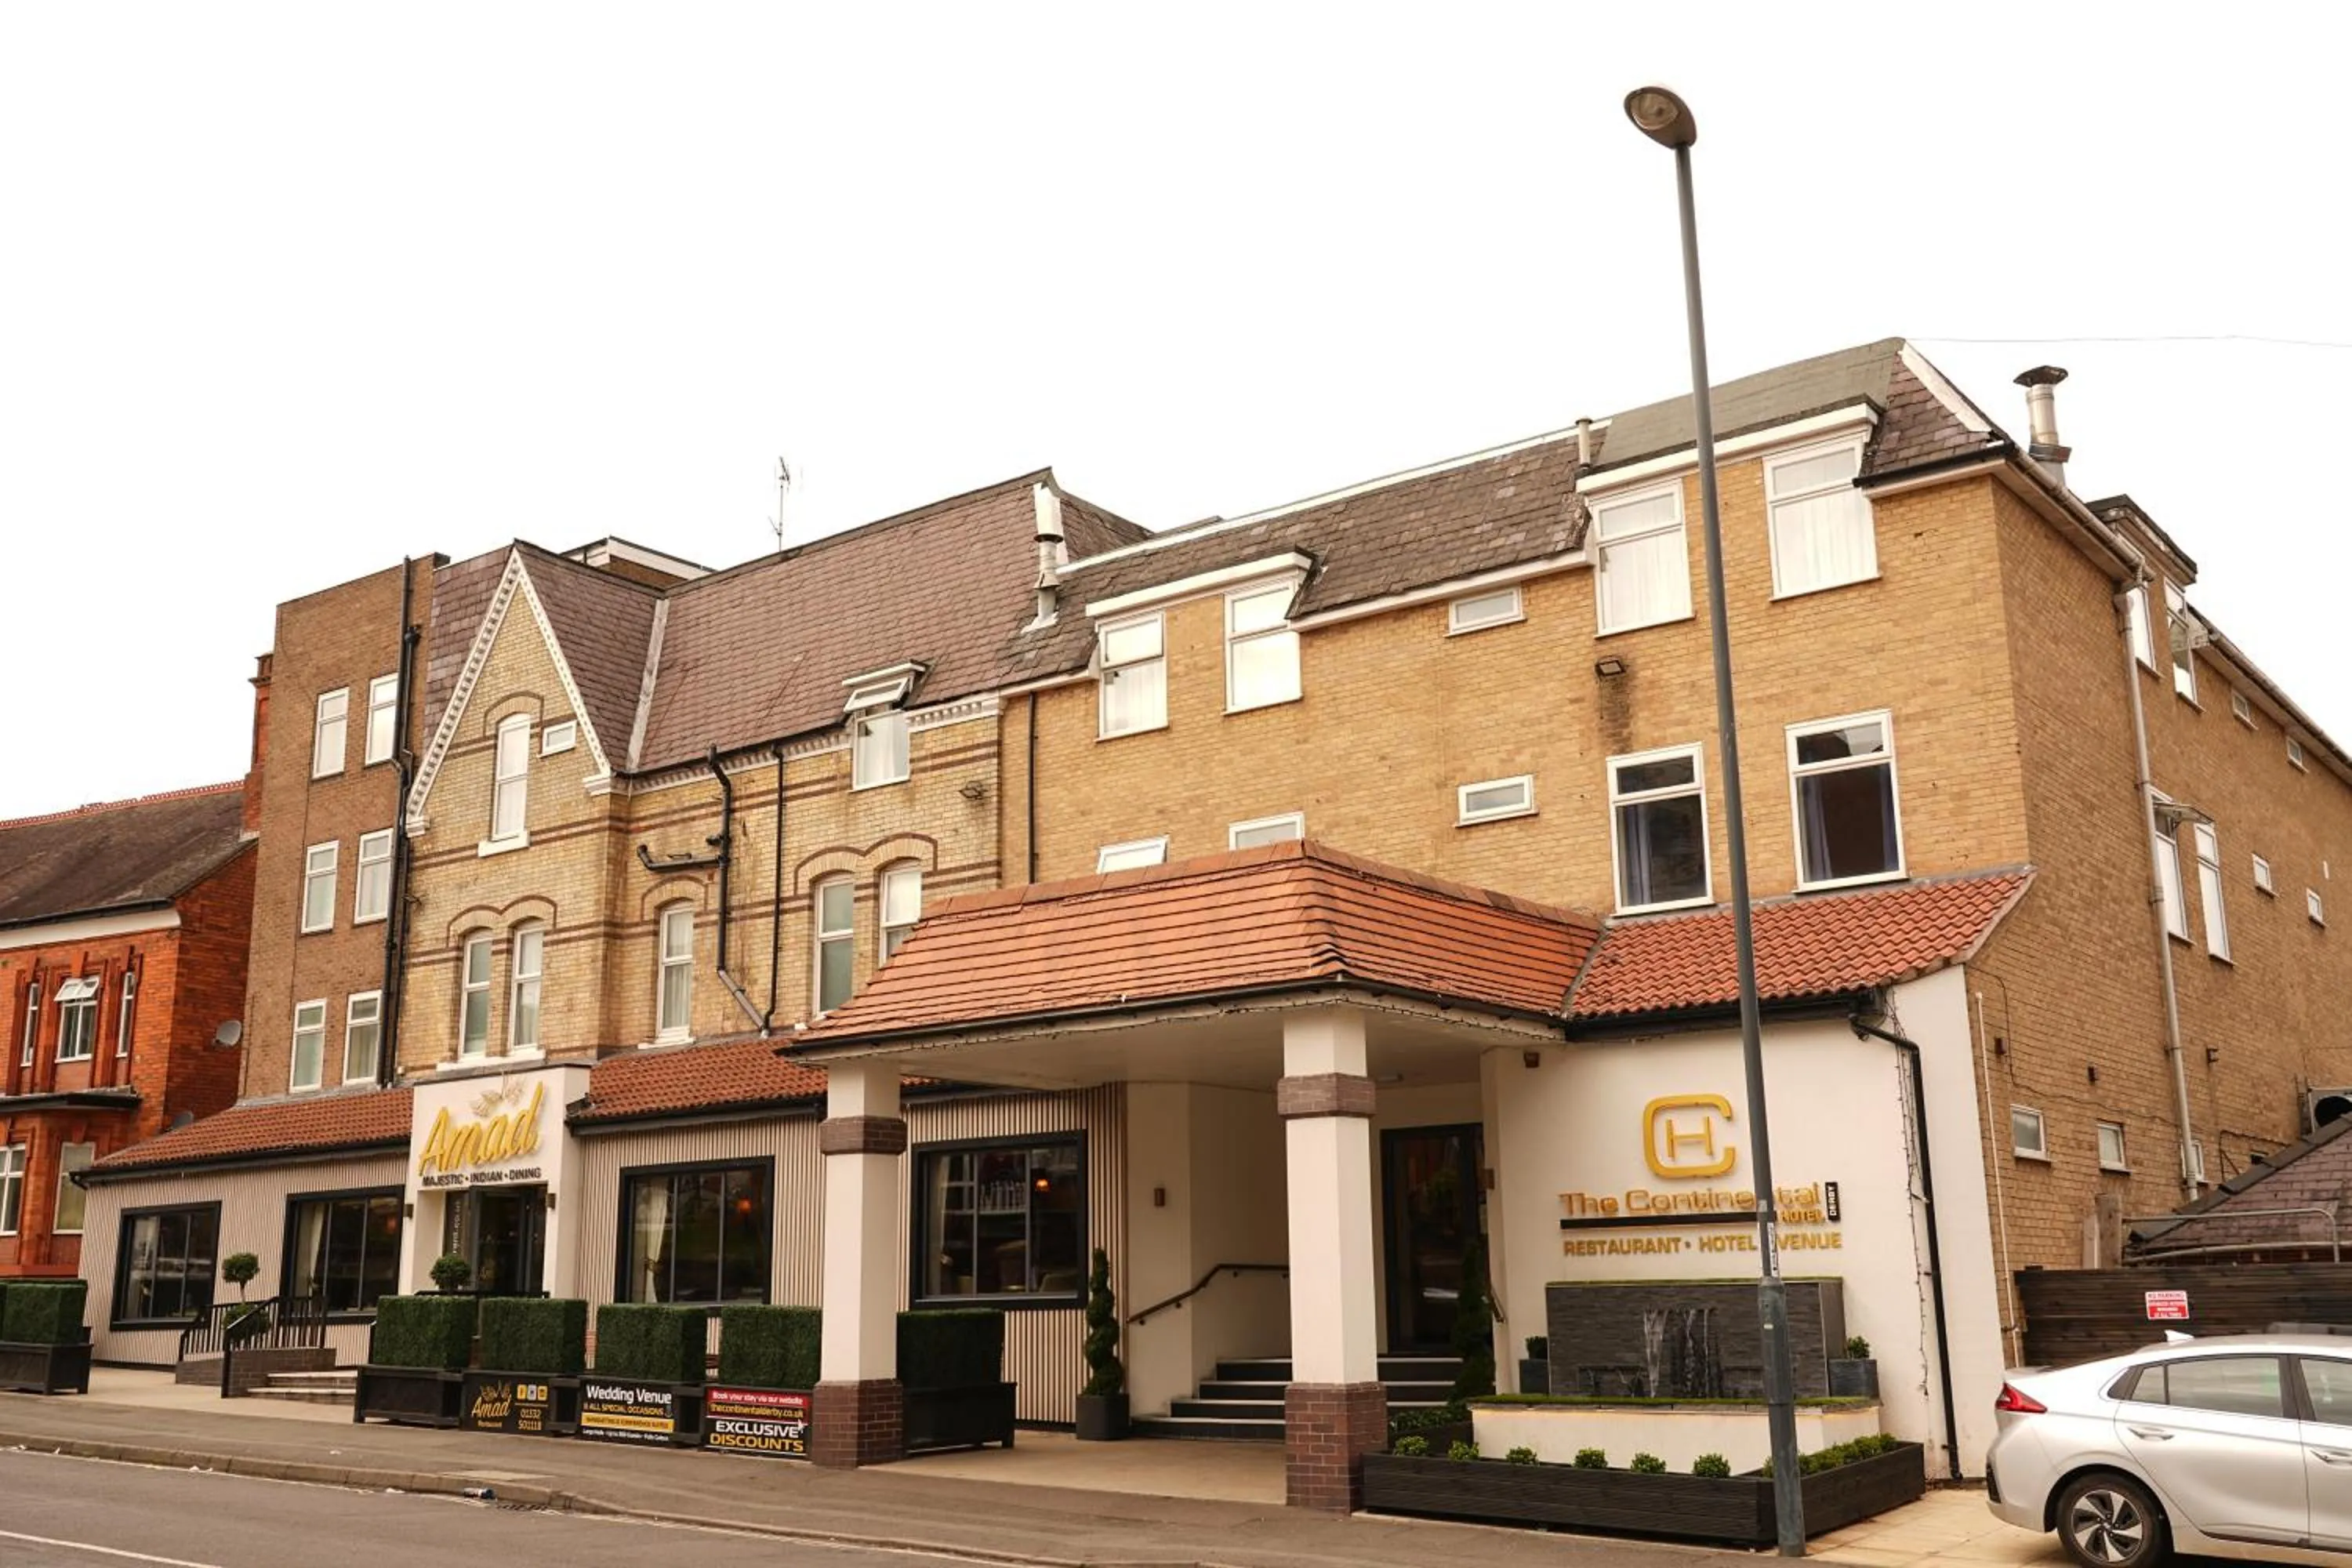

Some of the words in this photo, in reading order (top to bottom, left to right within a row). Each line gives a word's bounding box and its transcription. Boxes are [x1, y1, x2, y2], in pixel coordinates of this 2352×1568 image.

[418, 1080, 545, 1177] Amad
[422, 1174, 463, 1187] MAJESTIC
[470, 1171, 503, 1182] INDIAN
[509, 1167, 542, 1179] DINING
[1559, 1192, 1619, 1216] The
[1625, 1181, 1820, 1212] Continetal
[1780, 1209, 1825, 1223] HOTEL
[1563, 1236, 1682, 1256] RESTAURANT
[1699, 1233, 1758, 1252] HOTEL
[1775, 1231, 1842, 1250] VENUE
[586, 1384, 634, 1404] Wedding
[636, 1387, 672, 1404] Venue
[729, 1392, 742, 1401] your
[779, 1396, 803, 1405] website
[471, 1394, 512, 1418] Amad
[601, 1403, 626, 1413] SPECIAL
[627, 1406, 664, 1417] OCCASIONS
[715, 1420, 800, 1439] EXCLUSIVE
[710, 1432, 804, 1452] DISCOUNTS
